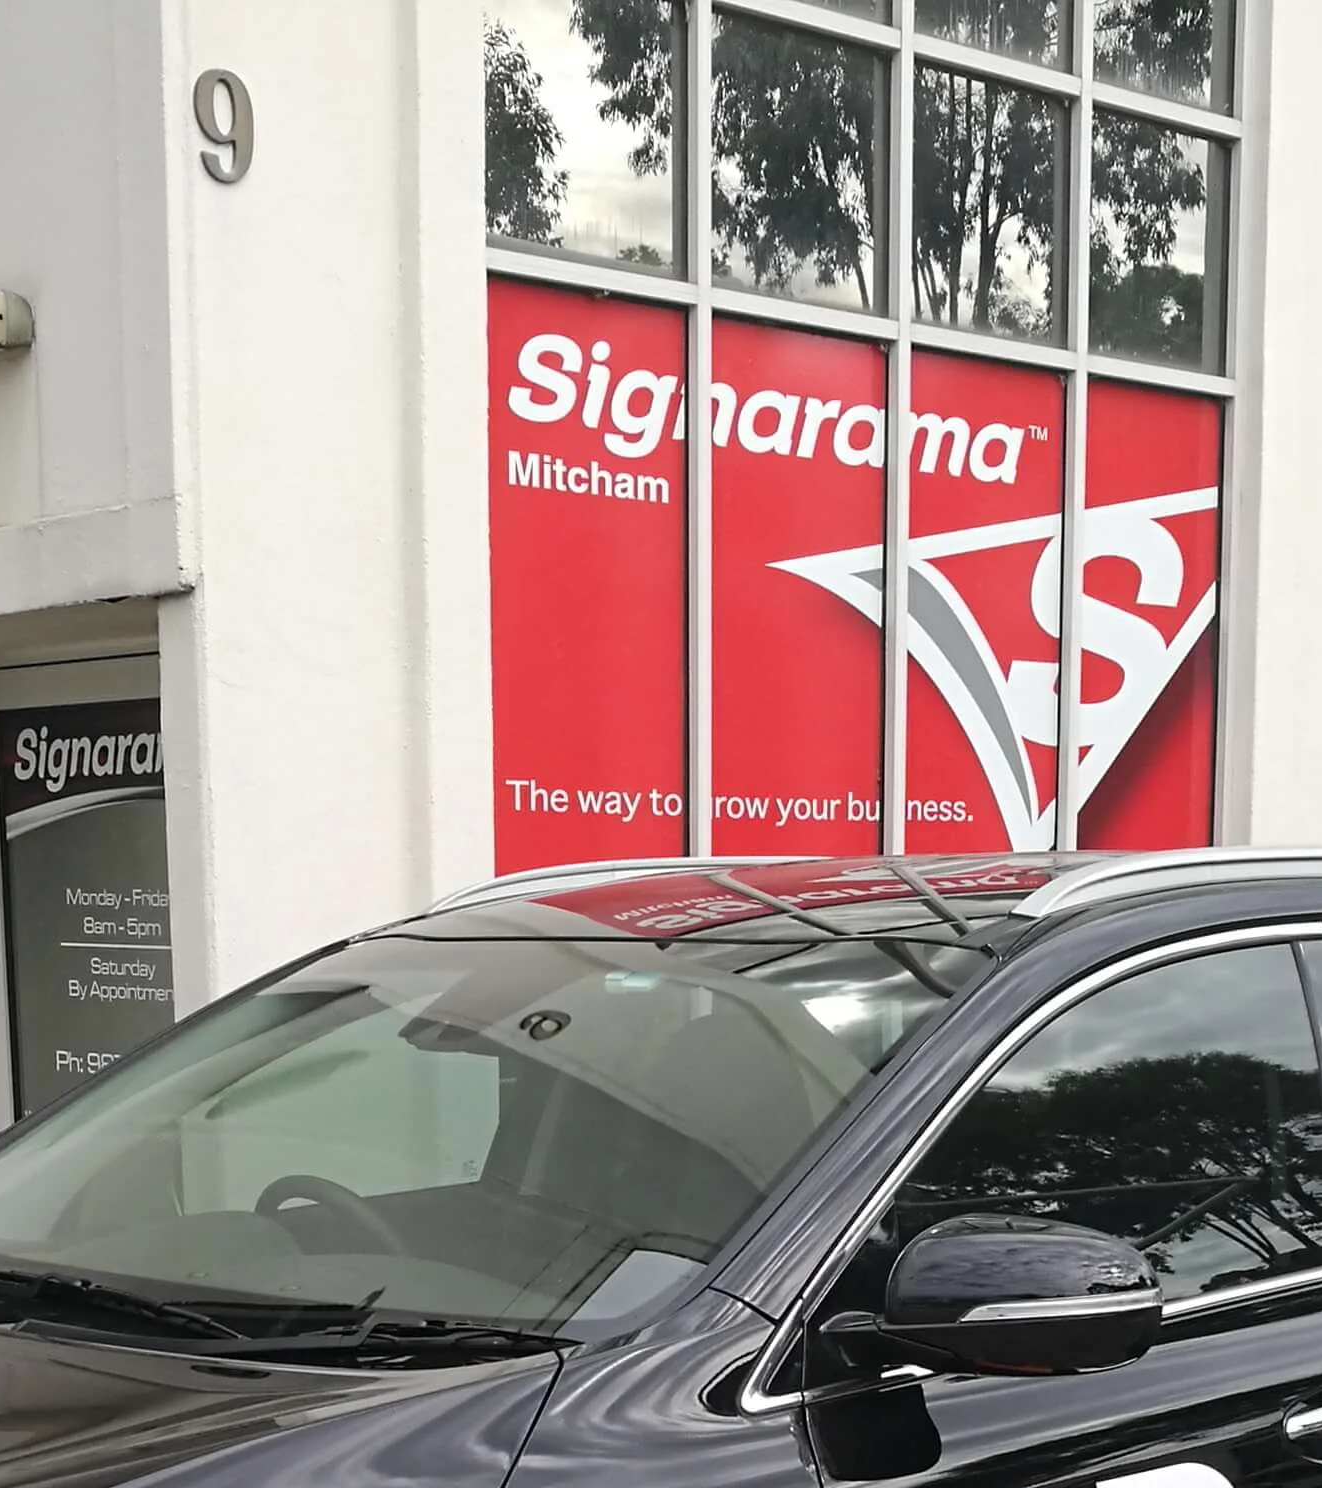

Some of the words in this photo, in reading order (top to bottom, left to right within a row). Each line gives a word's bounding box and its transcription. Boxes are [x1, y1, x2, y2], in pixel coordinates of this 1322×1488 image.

[193, 68, 254, 183] 9
[507, 449, 669, 504] Mitcham
[505, 779, 569, 814] The
[577, 790, 641, 823] way
[649, 787, 682, 817] to
[710, 795, 769, 820] row
[774, 795, 842, 828] your
[846, 792, 974, 822] buness.
[65, 887, 123, 910] Monday
[132, 888, 170, 908] Frida
[82, 916, 117, 935] 8am
[127, 917, 162, 939] 5pm
[90, 956, 157, 981] Saturday
[68, 979, 88, 1001] By
[89, 980, 174, 1002] Appointmen
[55, 1049, 84, 1073] Ph:
